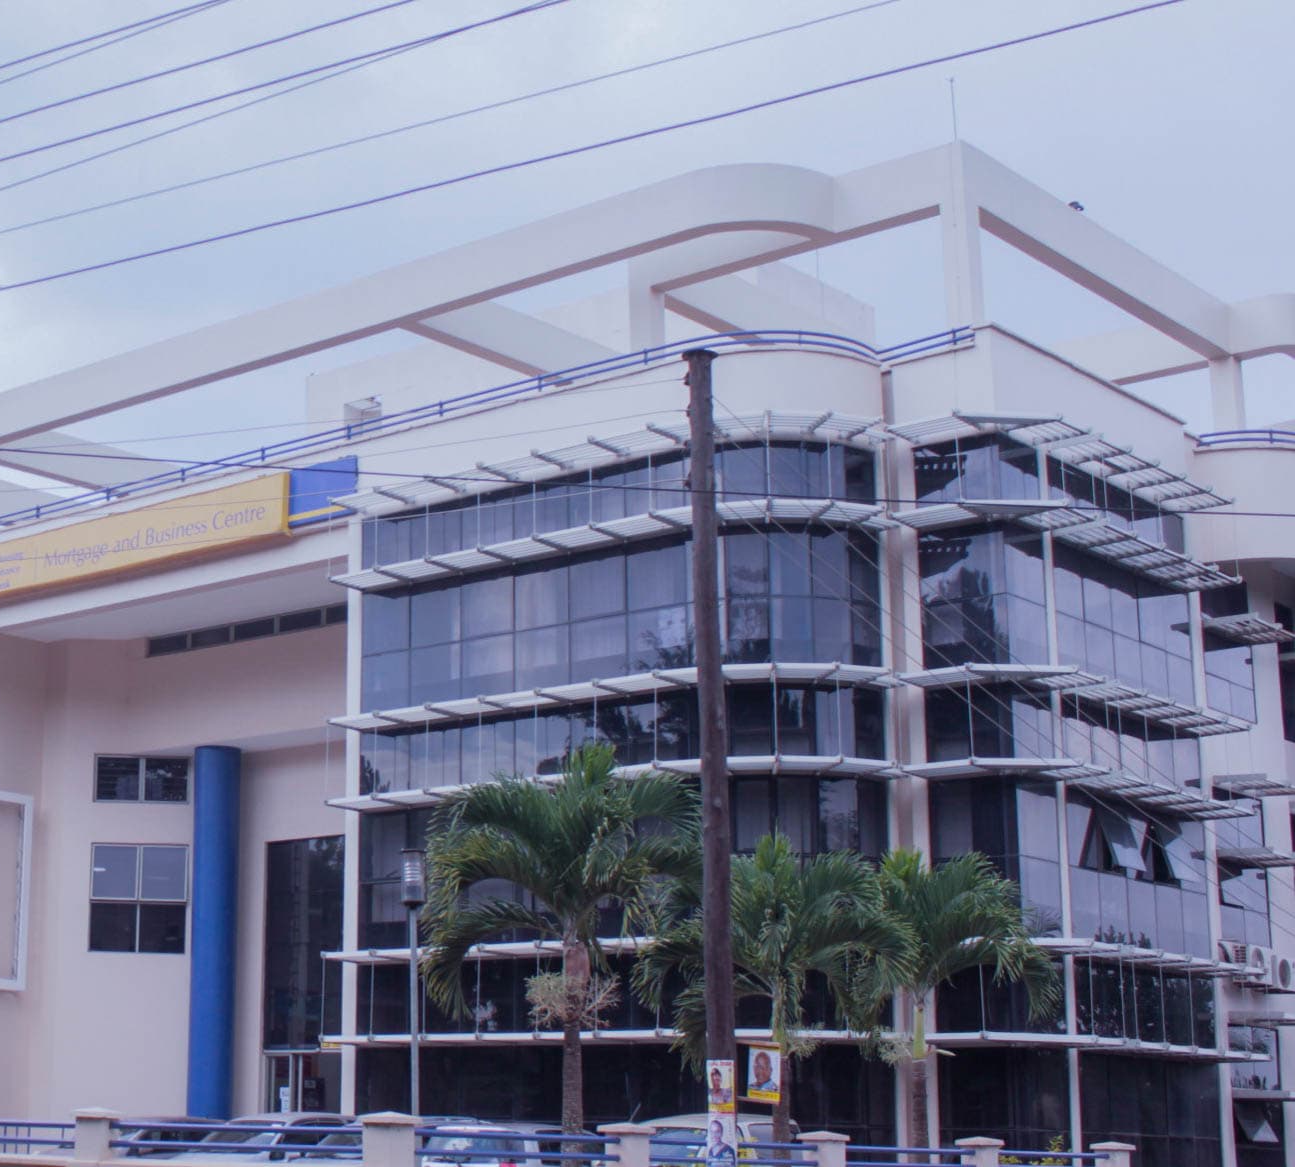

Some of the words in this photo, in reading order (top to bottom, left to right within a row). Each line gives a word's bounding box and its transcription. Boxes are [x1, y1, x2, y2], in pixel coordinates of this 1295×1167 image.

[44, 543, 109, 568] Mortgage
[113, 529, 141, 552] and
[145, 520, 209, 546] Business
[212, 506, 267, 531] Centre
